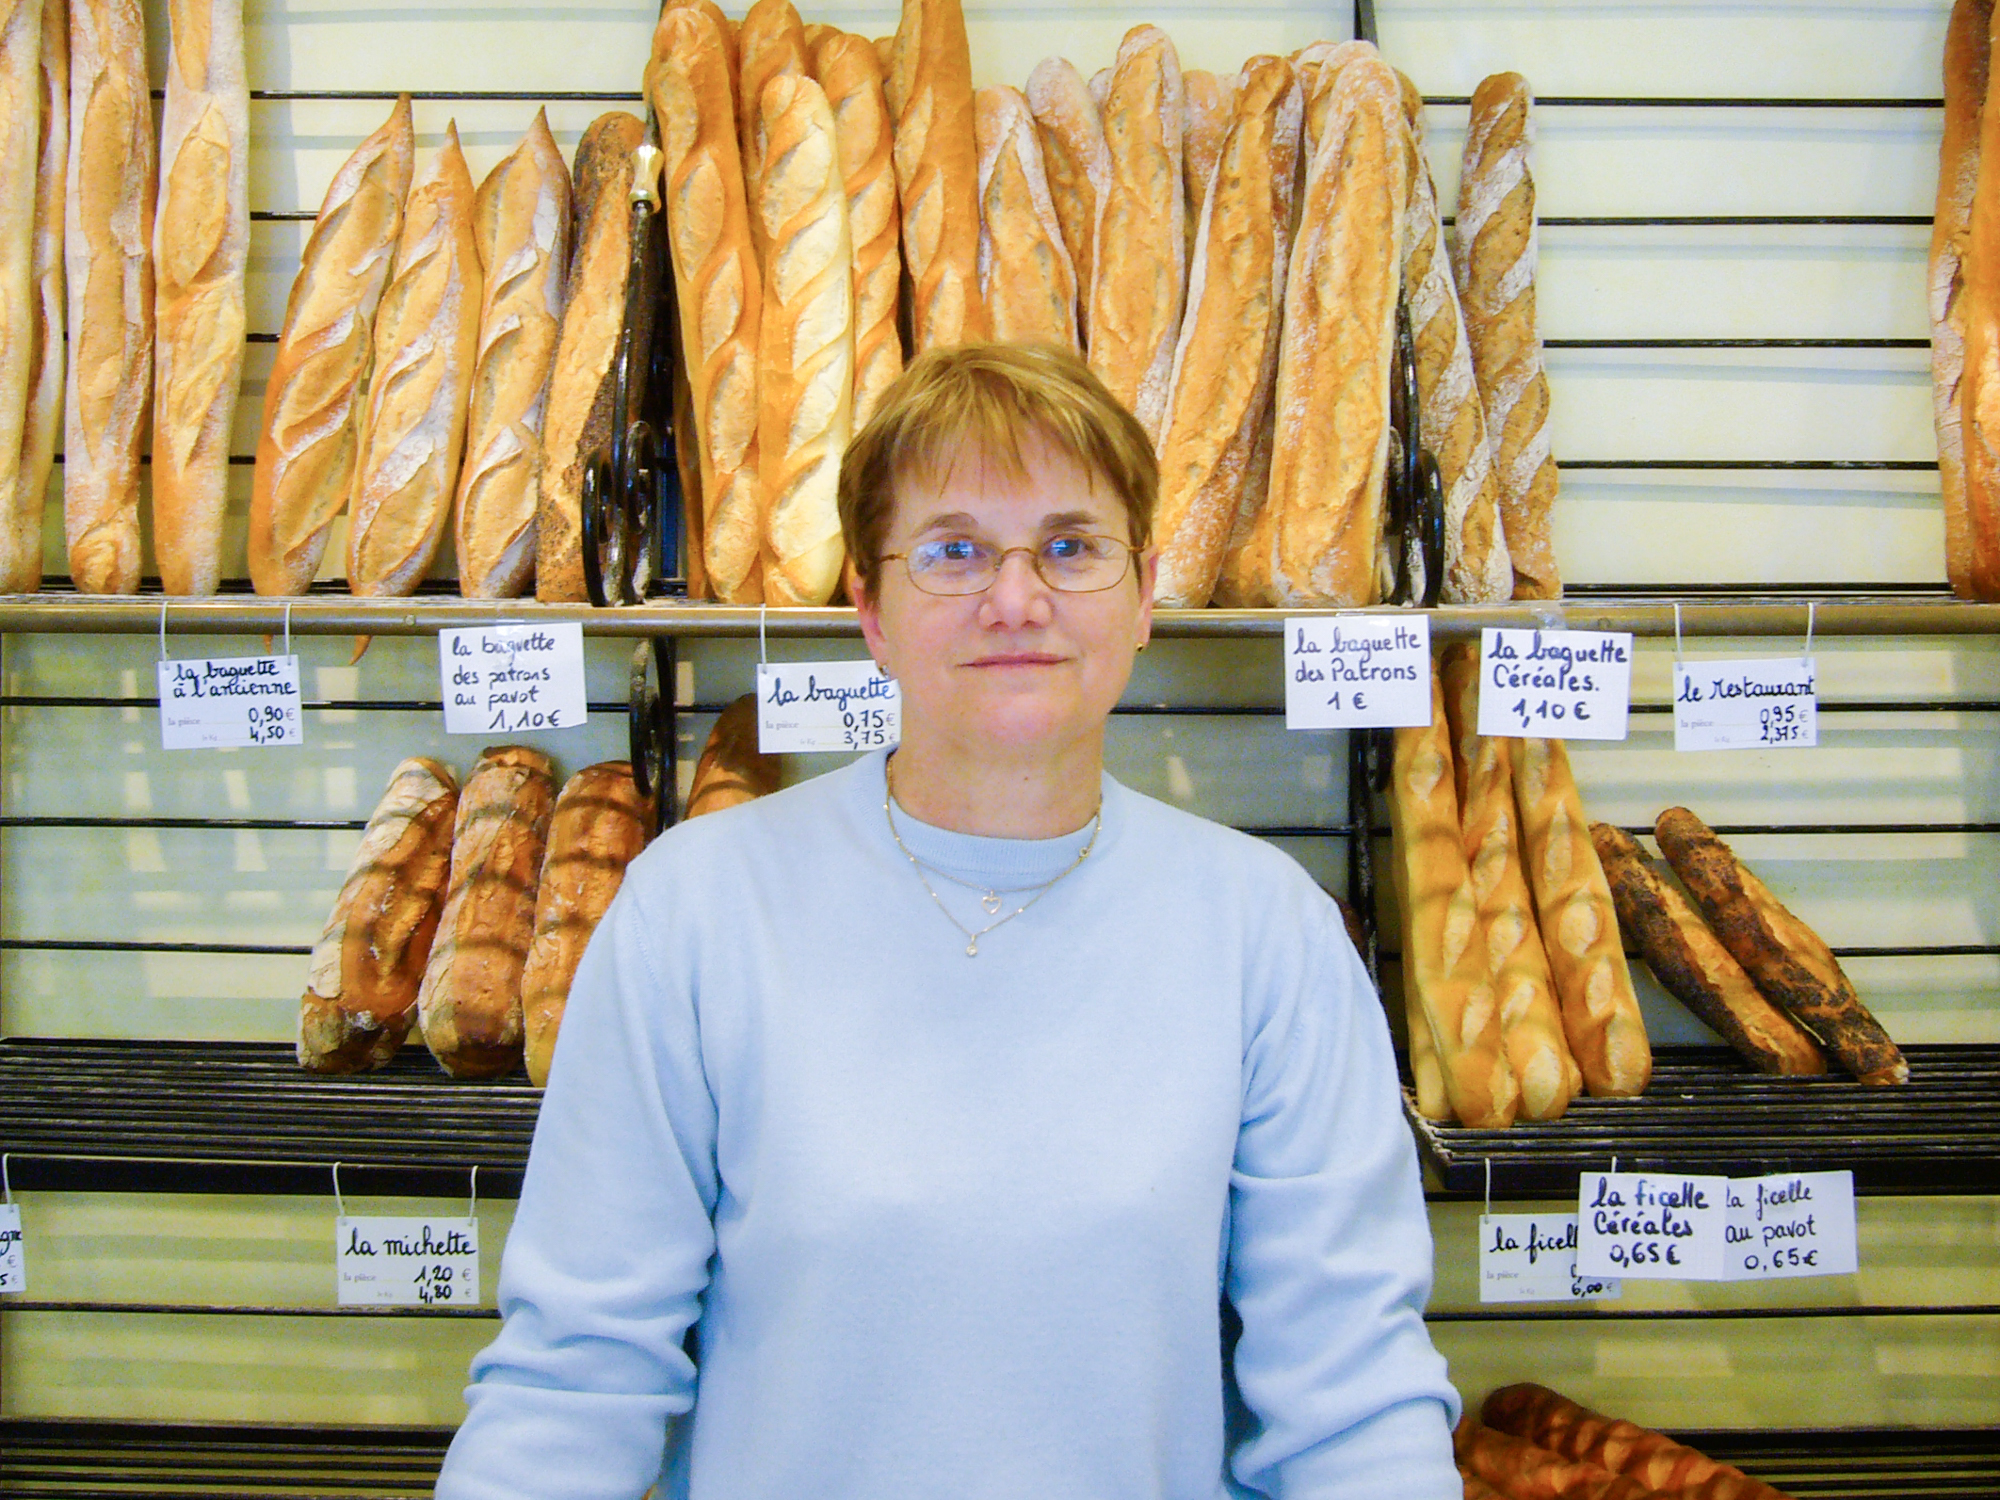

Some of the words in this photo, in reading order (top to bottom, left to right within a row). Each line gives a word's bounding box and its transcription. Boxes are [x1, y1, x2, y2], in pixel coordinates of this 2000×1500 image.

[452, 635, 472, 656] la
[481, 632, 555, 667] baguette
[1293, 627, 1322, 655] la
[1330, 626, 1422, 662] baguette
[1488, 631, 1519, 660] la
[1525, 630, 1628, 676] baguette
[172, 663, 200, 682] la
[202, 660, 280, 686] baguette
[452, 664, 479, 685] des
[488, 667, 550, 690] patrons
[1295, 660, 1325, 683] des
[1331, 657, 1417, 682] Patrons
[1493, 663, 1600, 692] Céréales.
[173, 682, 186, 698] à
[191, 675, 297, 698] l'ancienne
[454, 693, 476, 705] au
[488, 685, 540, 712] pavot
[767, 677, 800, 707] la
[804, 674, 896, 712] baguette
[1677, 674, 1703, 703] le
[1709, 675, 1815, 700] restaurant
[1327, 691, 1341, 711] 1
[1352, 692, 1369, 711] €
[248, 705, 284, 727] 0,90
[843, 709, 885, 732] 0,75
[1759, 704, 1796, 728] 0,95
[249, 726, 285, 744] 4,50
[843, 730, 885, 750] 3,75
[1590, 1176, 1626, 1208] la
[1634, 1179, 1710, 1209] ficelle
[1726, 1184, 1745, 1208] la
[1755, 1179, 1813, 1221] ficelle
[1594, 1207, 1693, 1238] Céréales
[1725, 1225, 1753, 1243] au
[1762, 1213, 1817, 1247] pavot
[345, 1226, 378, 1256] la
[382, 1225, 477, 1256] michette
[1489, 1226, 1520, 1253] la
[1524, 1223, 1578, 1265] ficell
[413, 1264, 453, 1287] 1,20
[1571, 1282, 1603, 1298] 6,00
